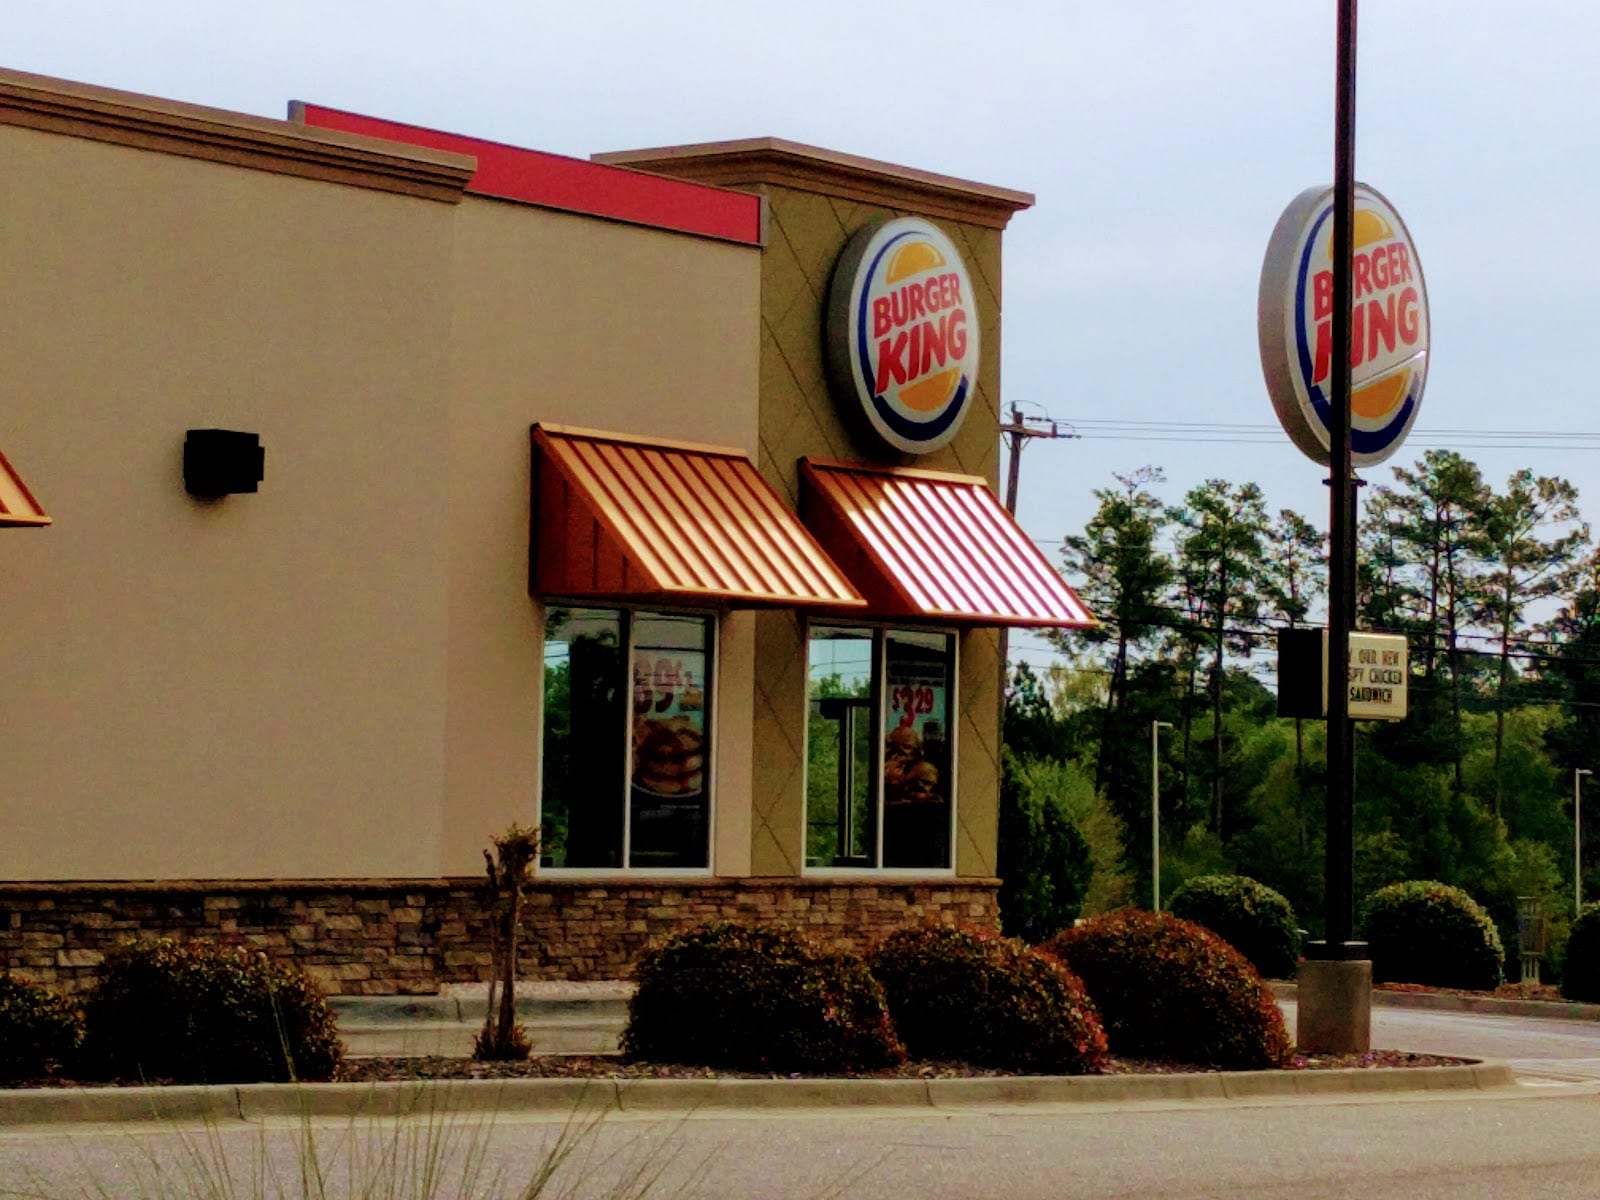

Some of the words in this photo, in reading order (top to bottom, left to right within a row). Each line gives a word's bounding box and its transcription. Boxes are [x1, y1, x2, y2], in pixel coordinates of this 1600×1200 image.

[872, 272, 962, 339] BURGER
[1313, 242, 1412, 322] BRGER
[875, 308, 967, 395] KING
[1350, 687, 1393, 703] SANDWICH
